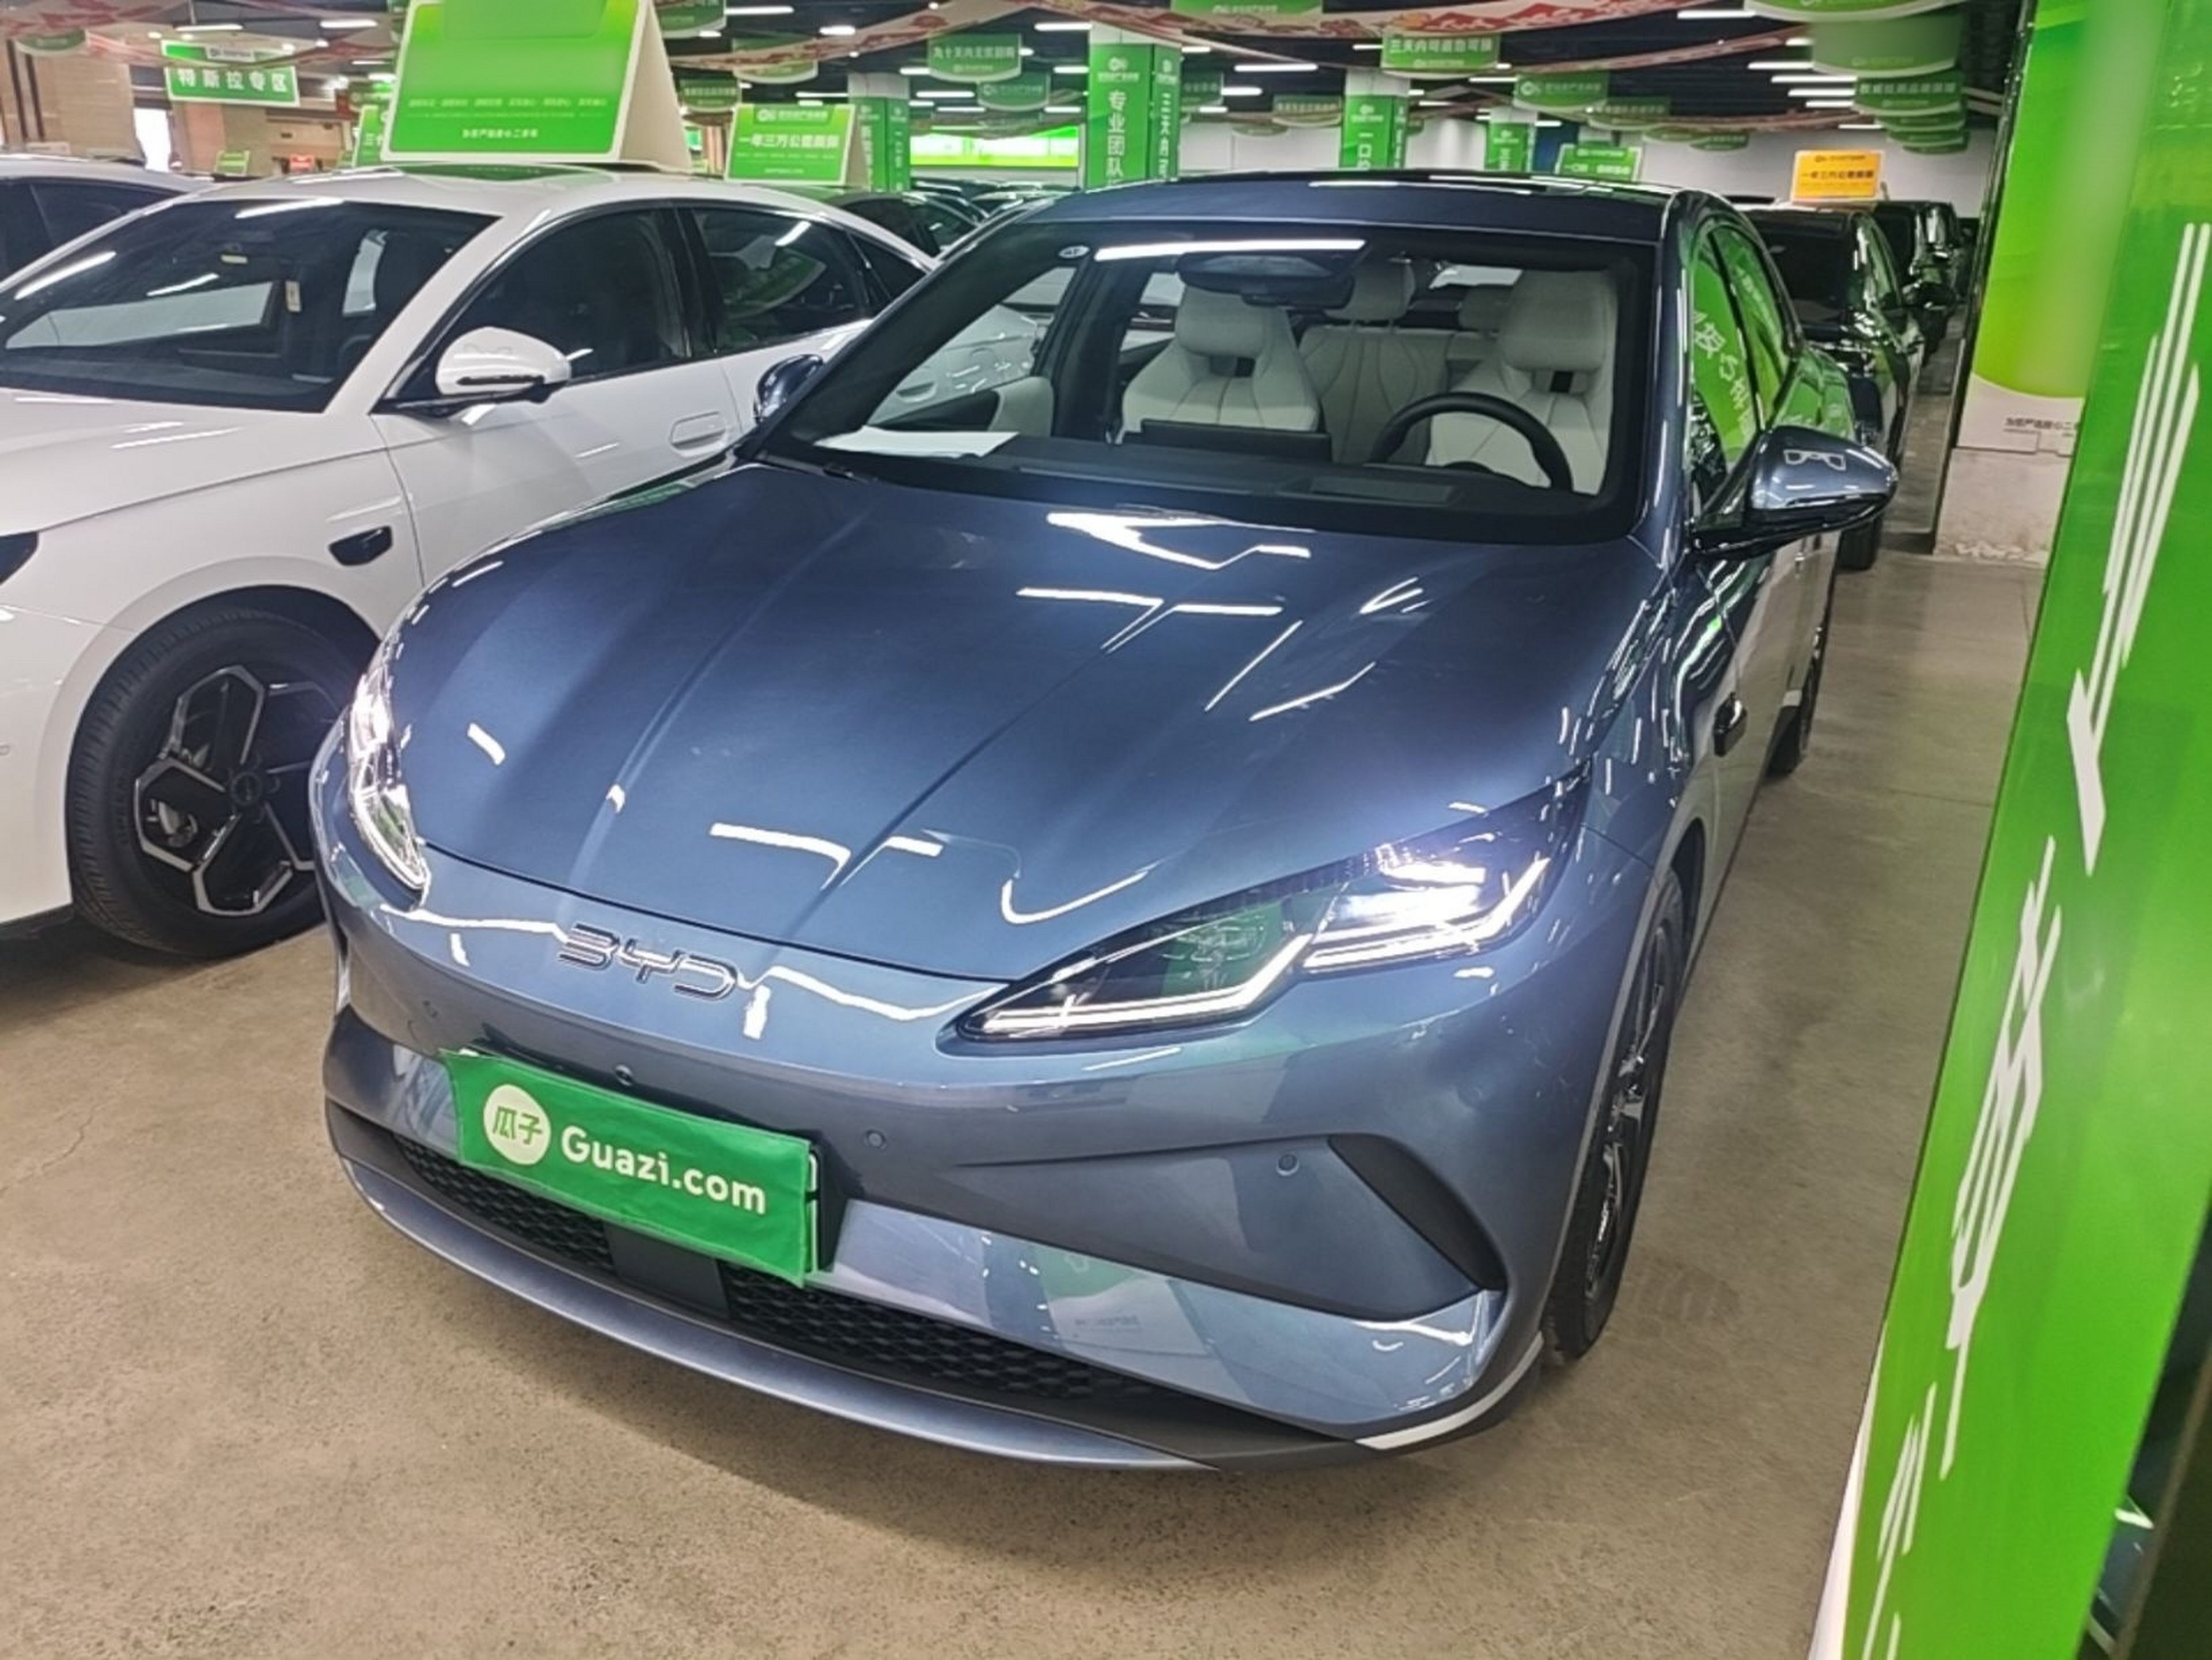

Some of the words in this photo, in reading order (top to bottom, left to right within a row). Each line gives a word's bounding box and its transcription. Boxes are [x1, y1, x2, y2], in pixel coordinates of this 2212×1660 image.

[1105, 89, 1127, 184] 专业团队
[559, 923, 738, 1001] BYD
[493, 1104, 543, 1147] 瓜子
[561, 1125, 766, 1215] Guazi.com
